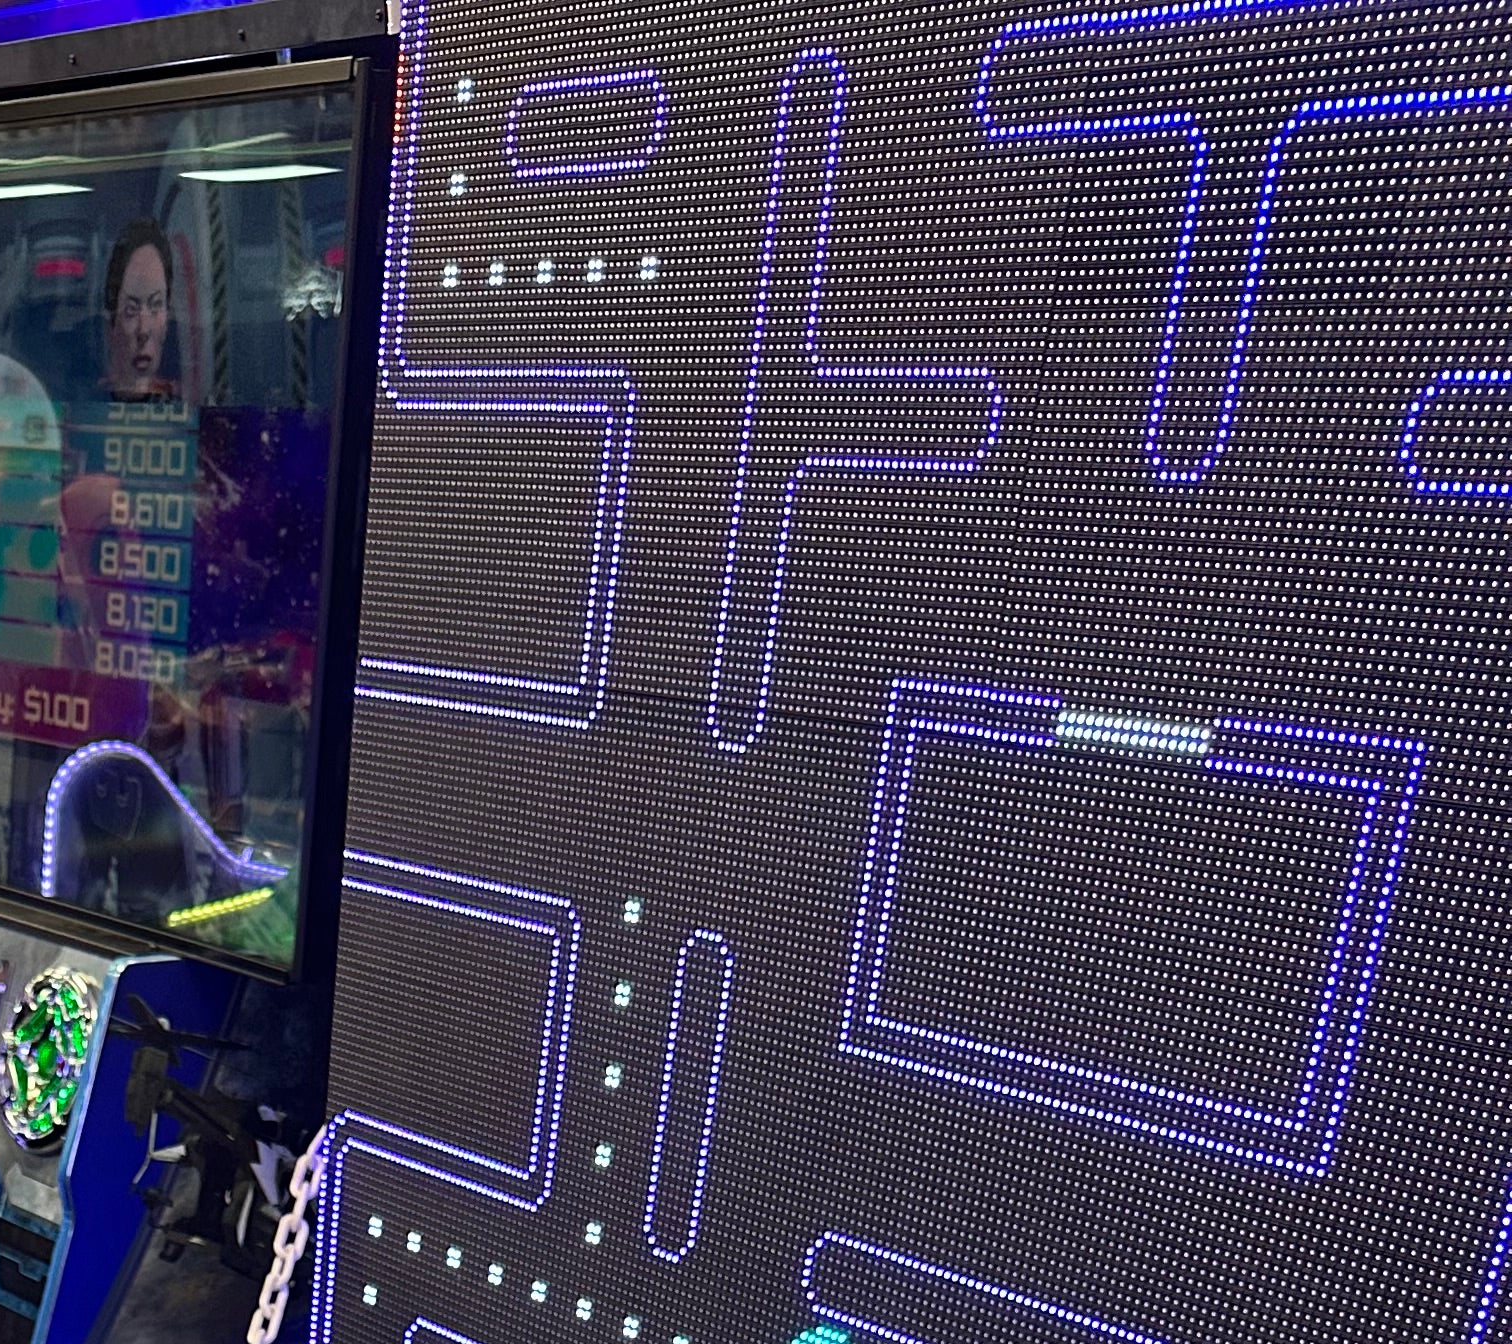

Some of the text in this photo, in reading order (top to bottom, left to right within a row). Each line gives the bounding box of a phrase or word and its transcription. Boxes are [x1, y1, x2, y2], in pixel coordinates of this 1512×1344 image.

[104, 437, 187, 479] 9,000
[111, 490, 183, 530] 8,610
[99, 541, 181, 582] 8,500
[106, 592, 178, 634] 8,130
[23, 684, 88, 731] $1.00
